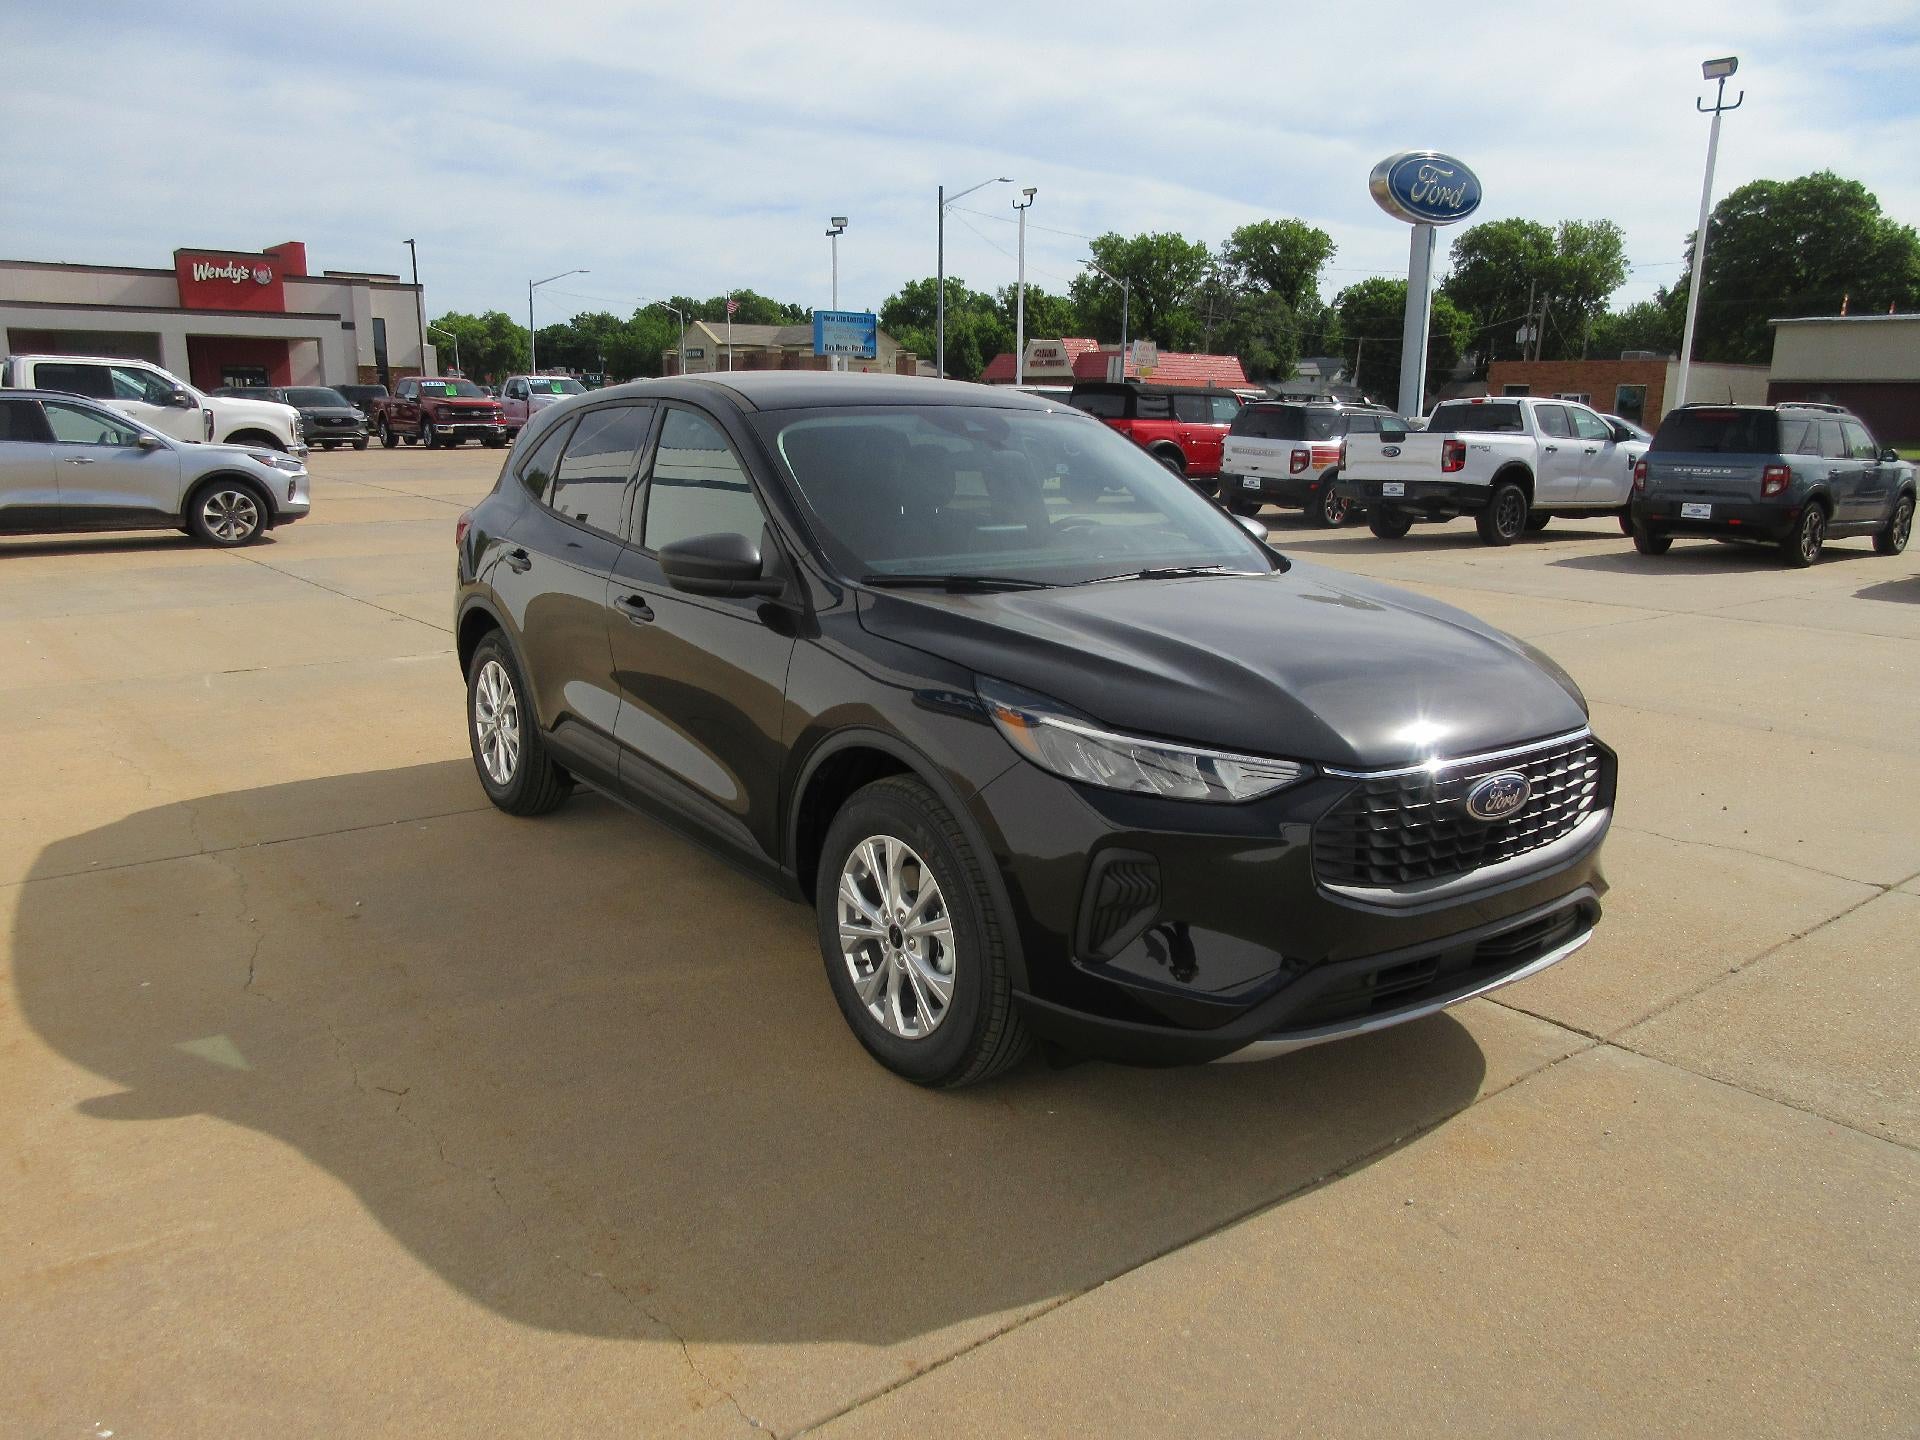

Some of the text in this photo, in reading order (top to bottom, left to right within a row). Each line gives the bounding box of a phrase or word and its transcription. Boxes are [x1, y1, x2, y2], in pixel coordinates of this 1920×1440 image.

[1411, 164, 1466, 209] Ford
[193, 261, 250, 284] Wendy's
[1485, 783, 1520, 811] Ford
